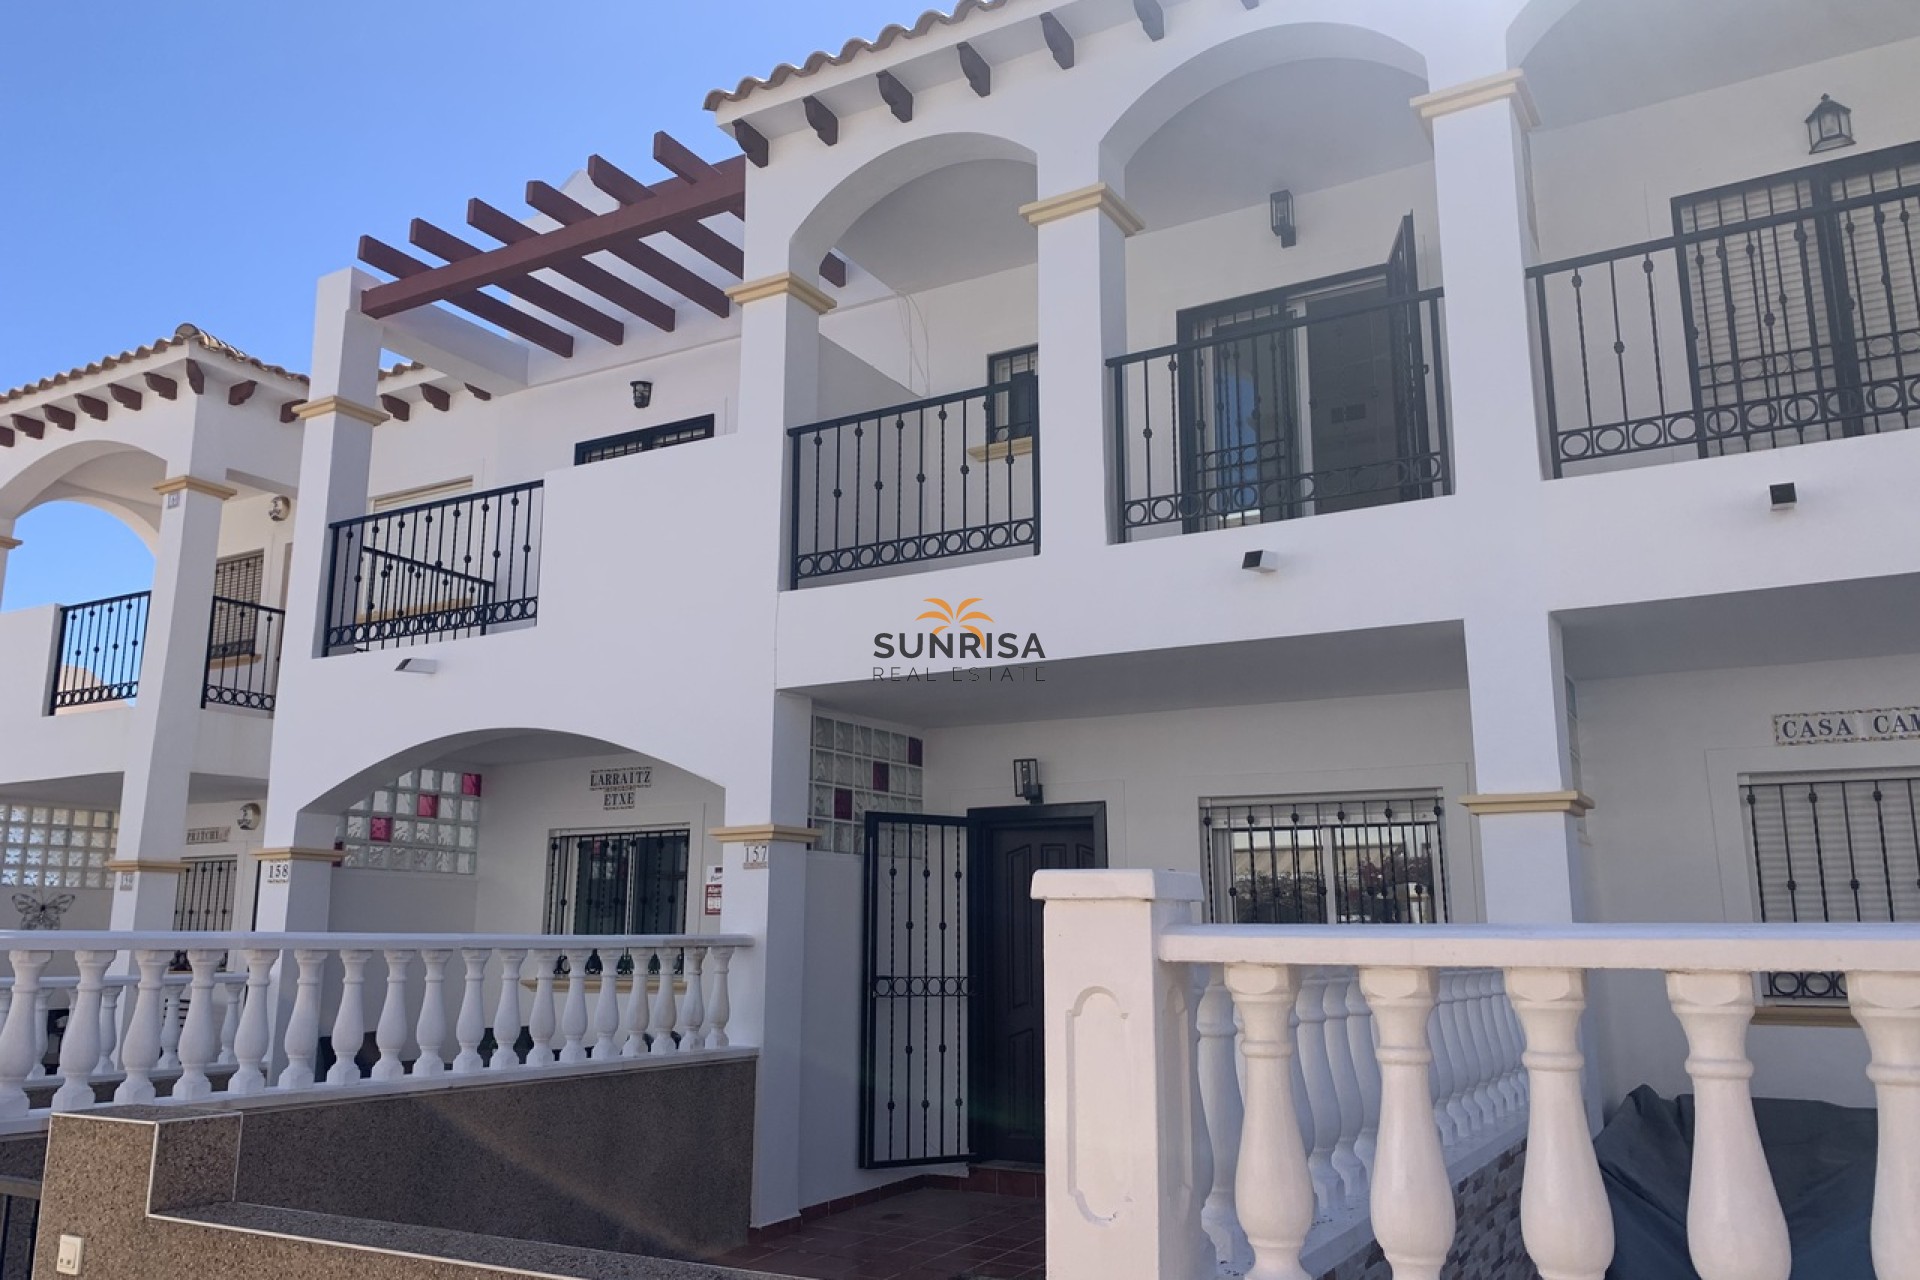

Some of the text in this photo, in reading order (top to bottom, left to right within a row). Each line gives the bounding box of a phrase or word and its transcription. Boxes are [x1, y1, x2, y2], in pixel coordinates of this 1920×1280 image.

[1782, 718, 1853, 738] CASA
[590, 771, 651, 786] LARRAITZ
[604, 792, 635, 806] ETXE
[745, 845, 767, 862] 157
[269, 863, 289, 879] 158
